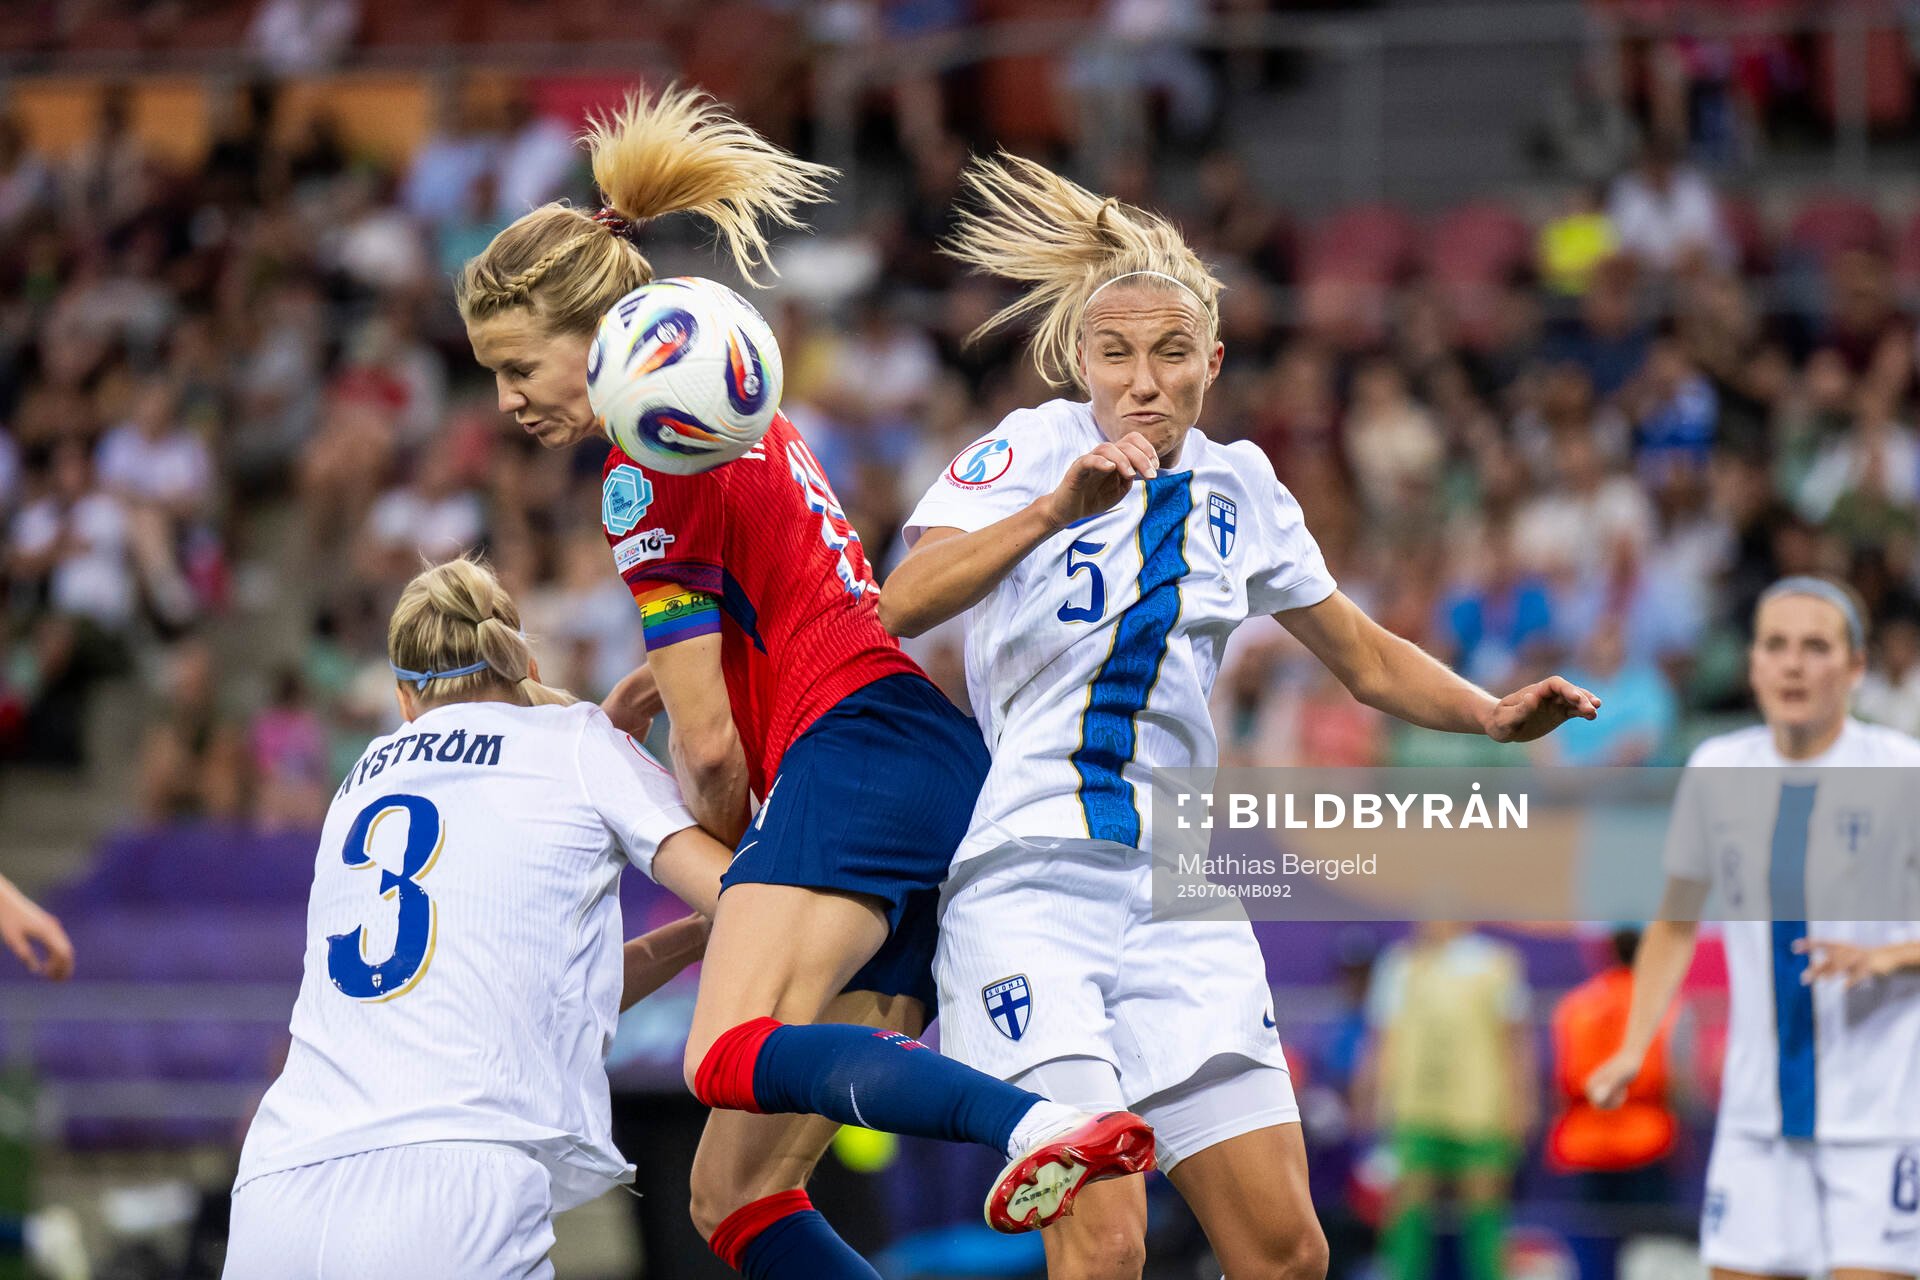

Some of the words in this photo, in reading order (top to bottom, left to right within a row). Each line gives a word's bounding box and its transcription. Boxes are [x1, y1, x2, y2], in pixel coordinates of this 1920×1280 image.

[1057, 539, 1109, 625] 5
[326, 793, 446, 1004] 3
[988, 980, 1020, 996] SUOMI
